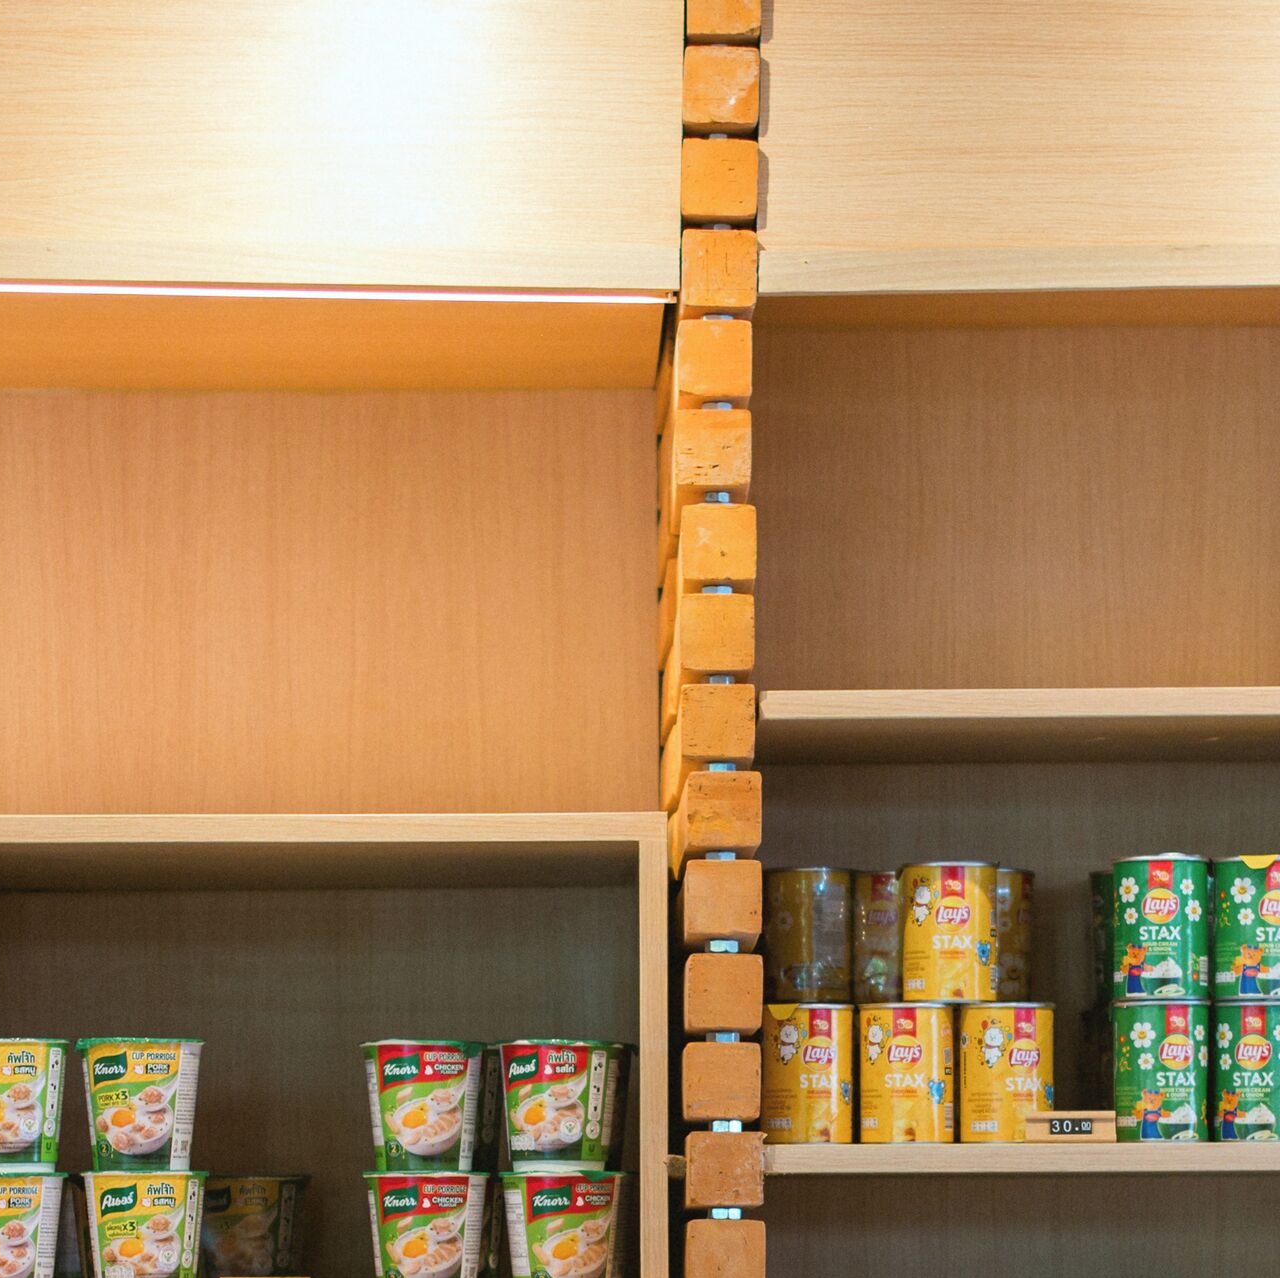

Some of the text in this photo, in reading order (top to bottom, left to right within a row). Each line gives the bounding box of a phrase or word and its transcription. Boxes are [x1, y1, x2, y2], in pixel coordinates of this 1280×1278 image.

[1145, 897, 1177, 916] Lay's
[937, 905, 969, 924] Lay's
[1139, 926, 1181, 940] STAX
[932, 935, 972, 949] STAX
[132, 1052, 144, 1060] CUP
[805, 1045, 836, 1063] Lay's
[889, 1044, 921, 1063] Lay's
[1011, 1049, 1039, 1067] Lay's
[1161, 1043, 1192, 1062] Lay's
[1237, 1043, 1269, 1062] Lay's
[94, 1063, 126, 1075] Knorr
[383, 1063, 419, 1076] Knorr
[885, 1074, 926, 1088] STAX
[1004, 1077, 1042, 1092] STAX
[1156, 1072, 1196, 1086] STAX
[1233, 1072, 1273, 1086] STAX
[1052, 1120, 1091, 1133] 30.00
[383, 1195, 417, 1207] Knorr
[532, 1195, 570, 1207] Knorr
